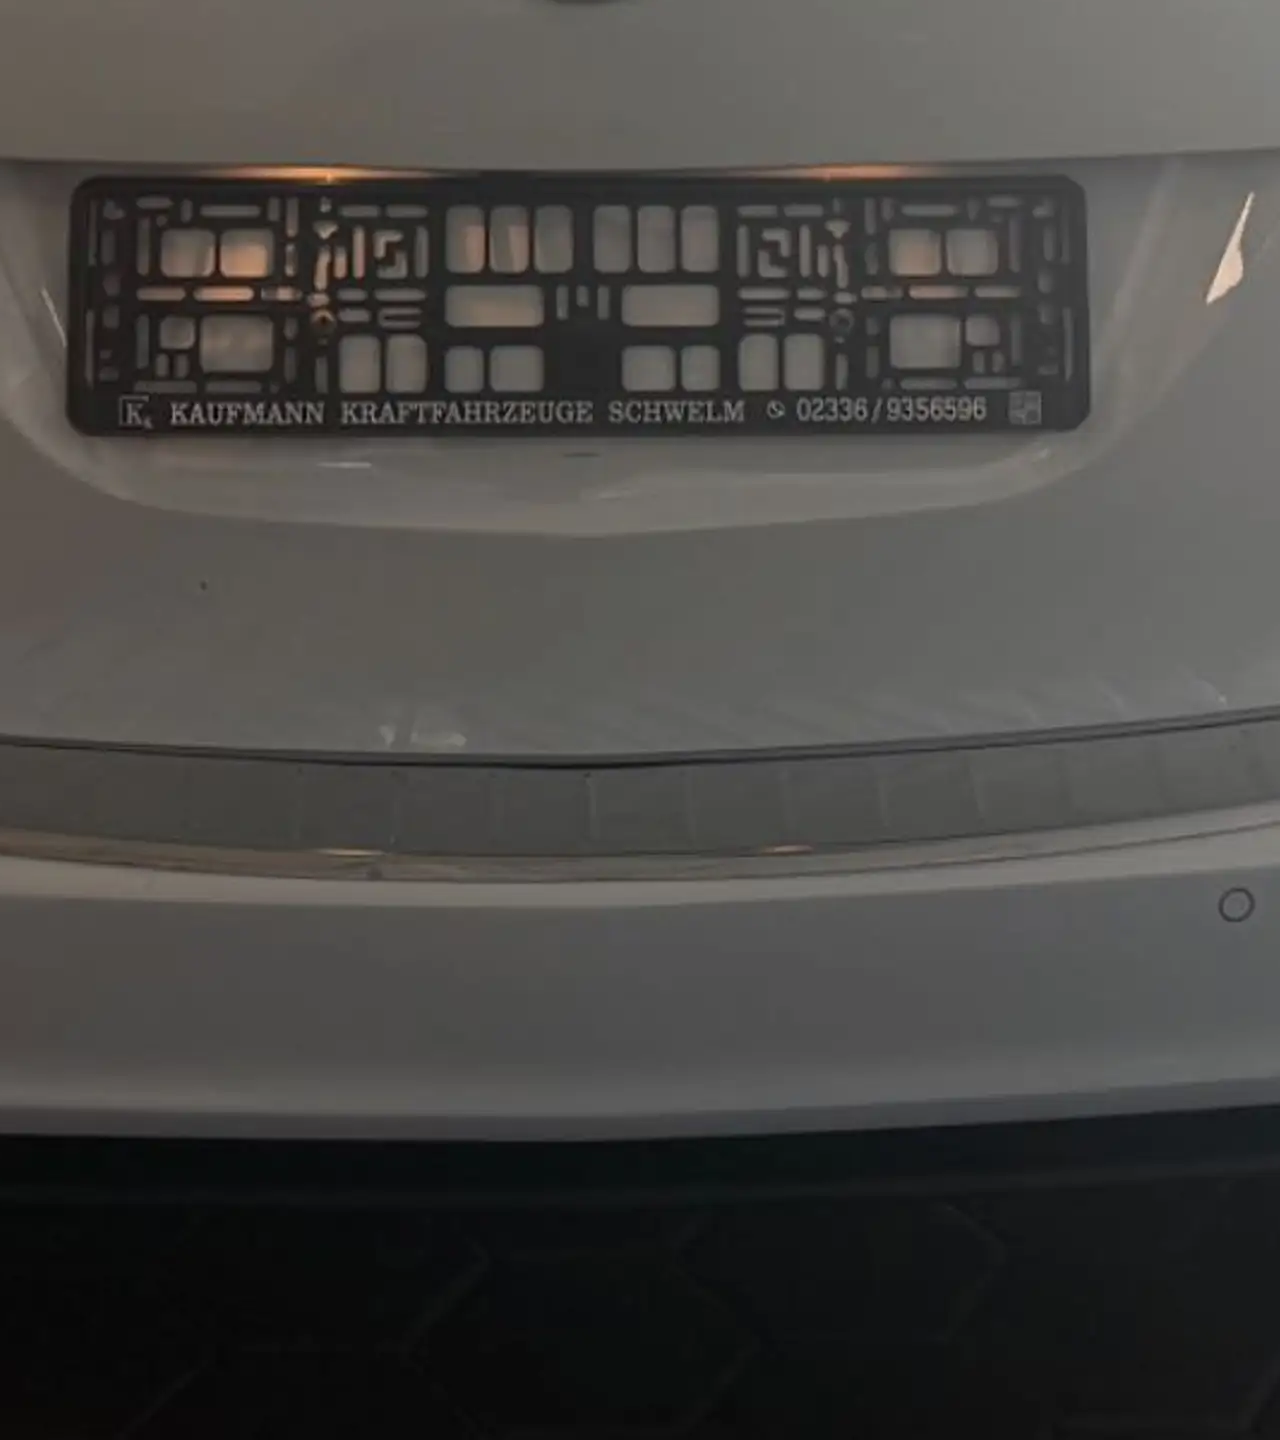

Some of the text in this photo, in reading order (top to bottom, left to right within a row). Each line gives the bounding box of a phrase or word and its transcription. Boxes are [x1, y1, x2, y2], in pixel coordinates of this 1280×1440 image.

[170, 401, 324, 426] KAUFMANN
[340, 400, 594, 425] KRAFTFAHRZEUGE
[608, 399, 746, 424] SCHWELM
